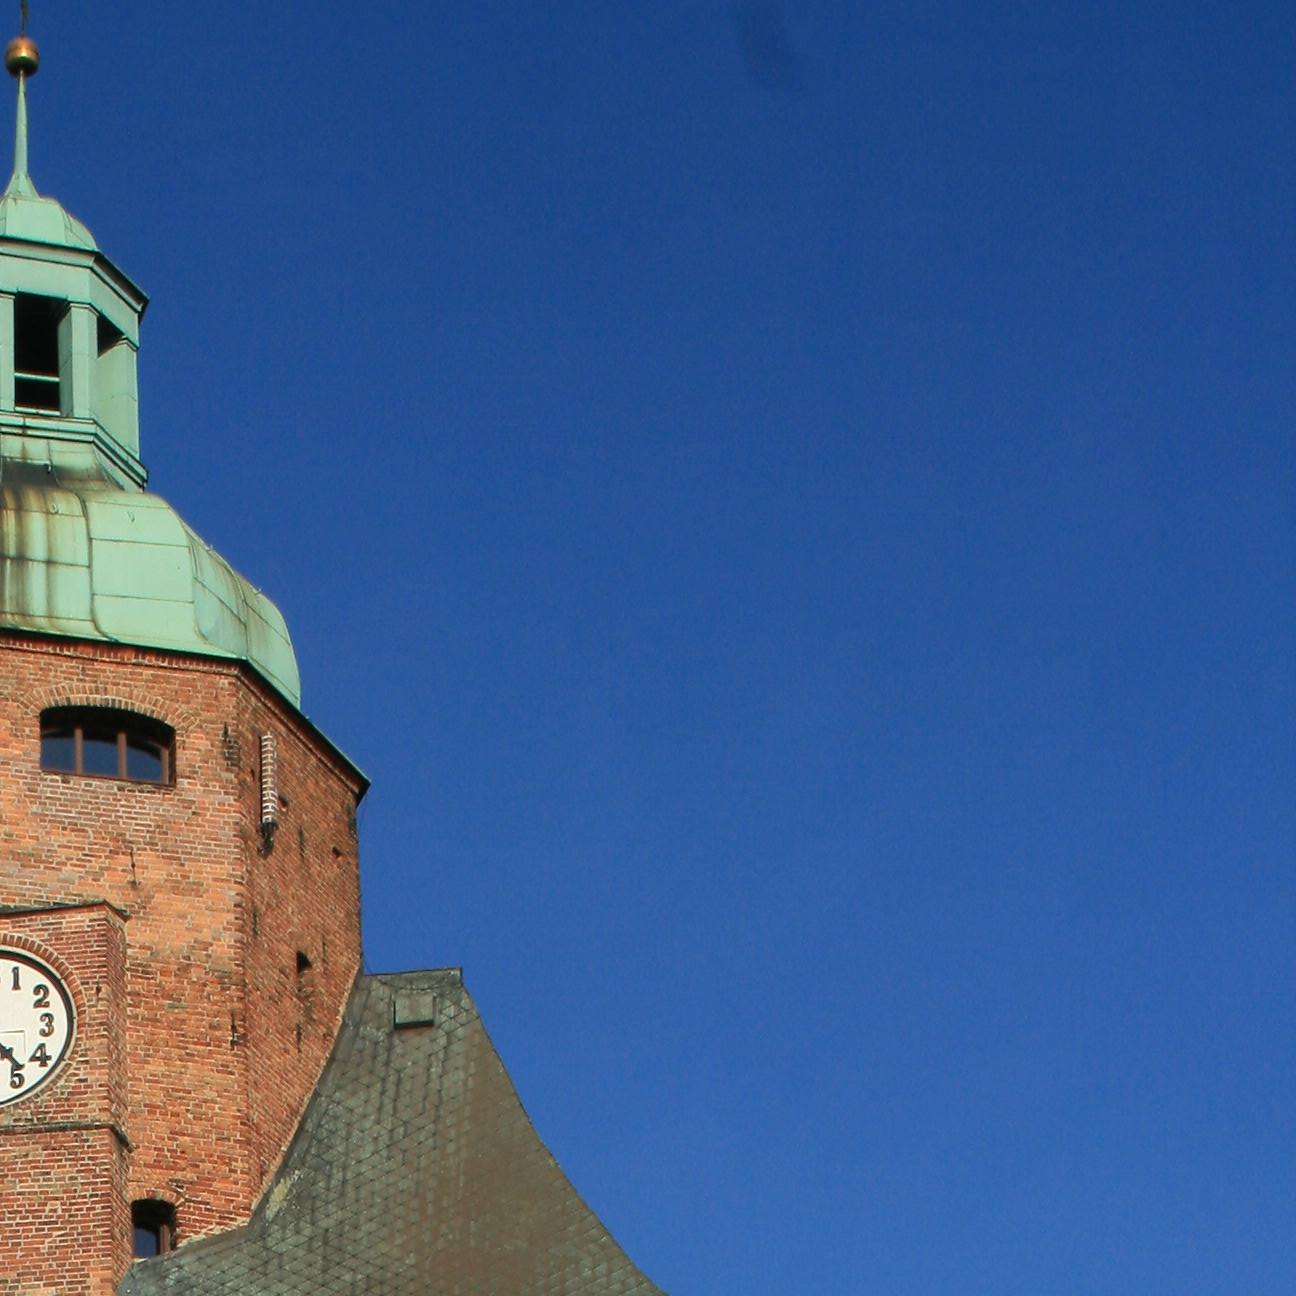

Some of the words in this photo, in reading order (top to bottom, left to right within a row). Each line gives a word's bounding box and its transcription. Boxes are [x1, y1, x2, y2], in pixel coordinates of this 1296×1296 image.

[11, 966, 22, 991] 1
[33, 984, 50, 1009] 2
[39, 1012, 55, 1037] 3
[28, 1043, 52, 1067] 4
[10, 1064, 25, 1089] 5
